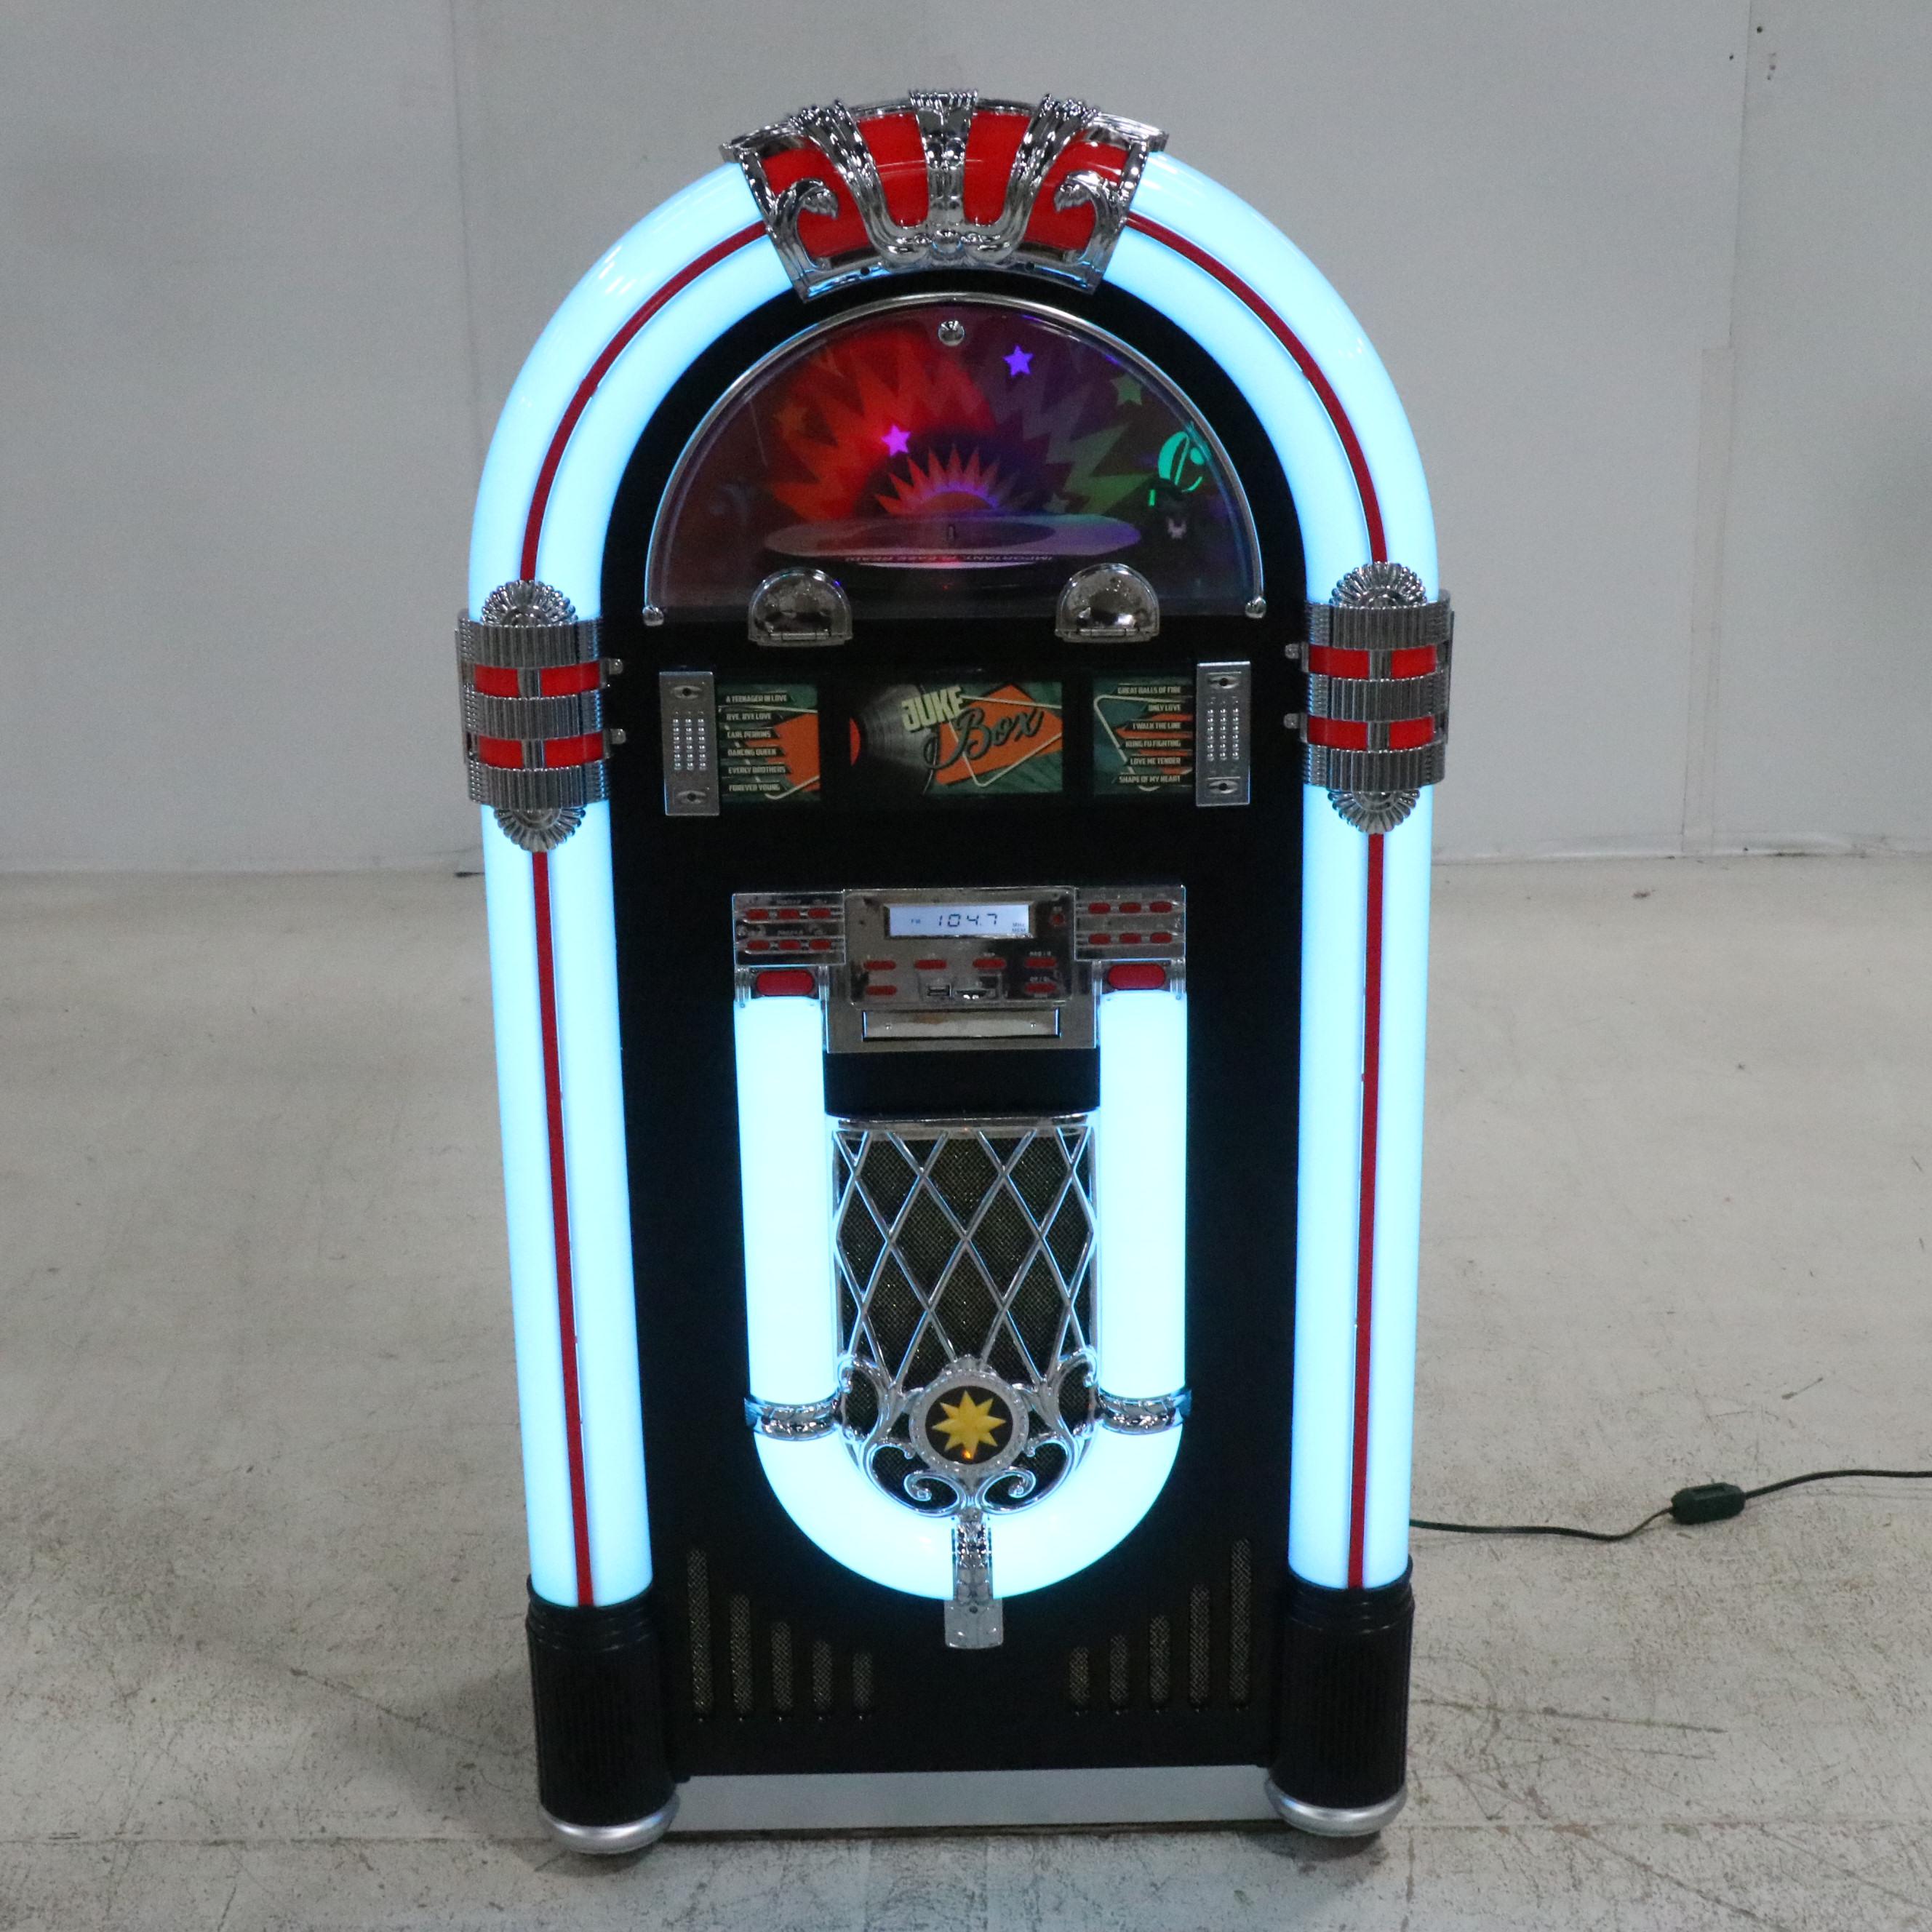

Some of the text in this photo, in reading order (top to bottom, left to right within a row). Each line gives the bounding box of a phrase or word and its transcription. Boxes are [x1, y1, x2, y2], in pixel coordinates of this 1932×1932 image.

[732, 695, 764, 703] TEENAGER
[771, 694, 787, 702] LOVE
[901, 685, 964, 732] JUKE
[727, 730, 771, 739] CARL PERKINS
[922, 706, 1045, 771] Box
[1152, 740, 1181, 748] FIGHTING
[727, 749, 755, 757] DANCING
[752, 766, 786, 774] BROTHERS
[1119, 775, 1140, 783] SHAPE
[729, 784, 758, 792] FOREVER
[938, 913, 998, 927] 104.7
